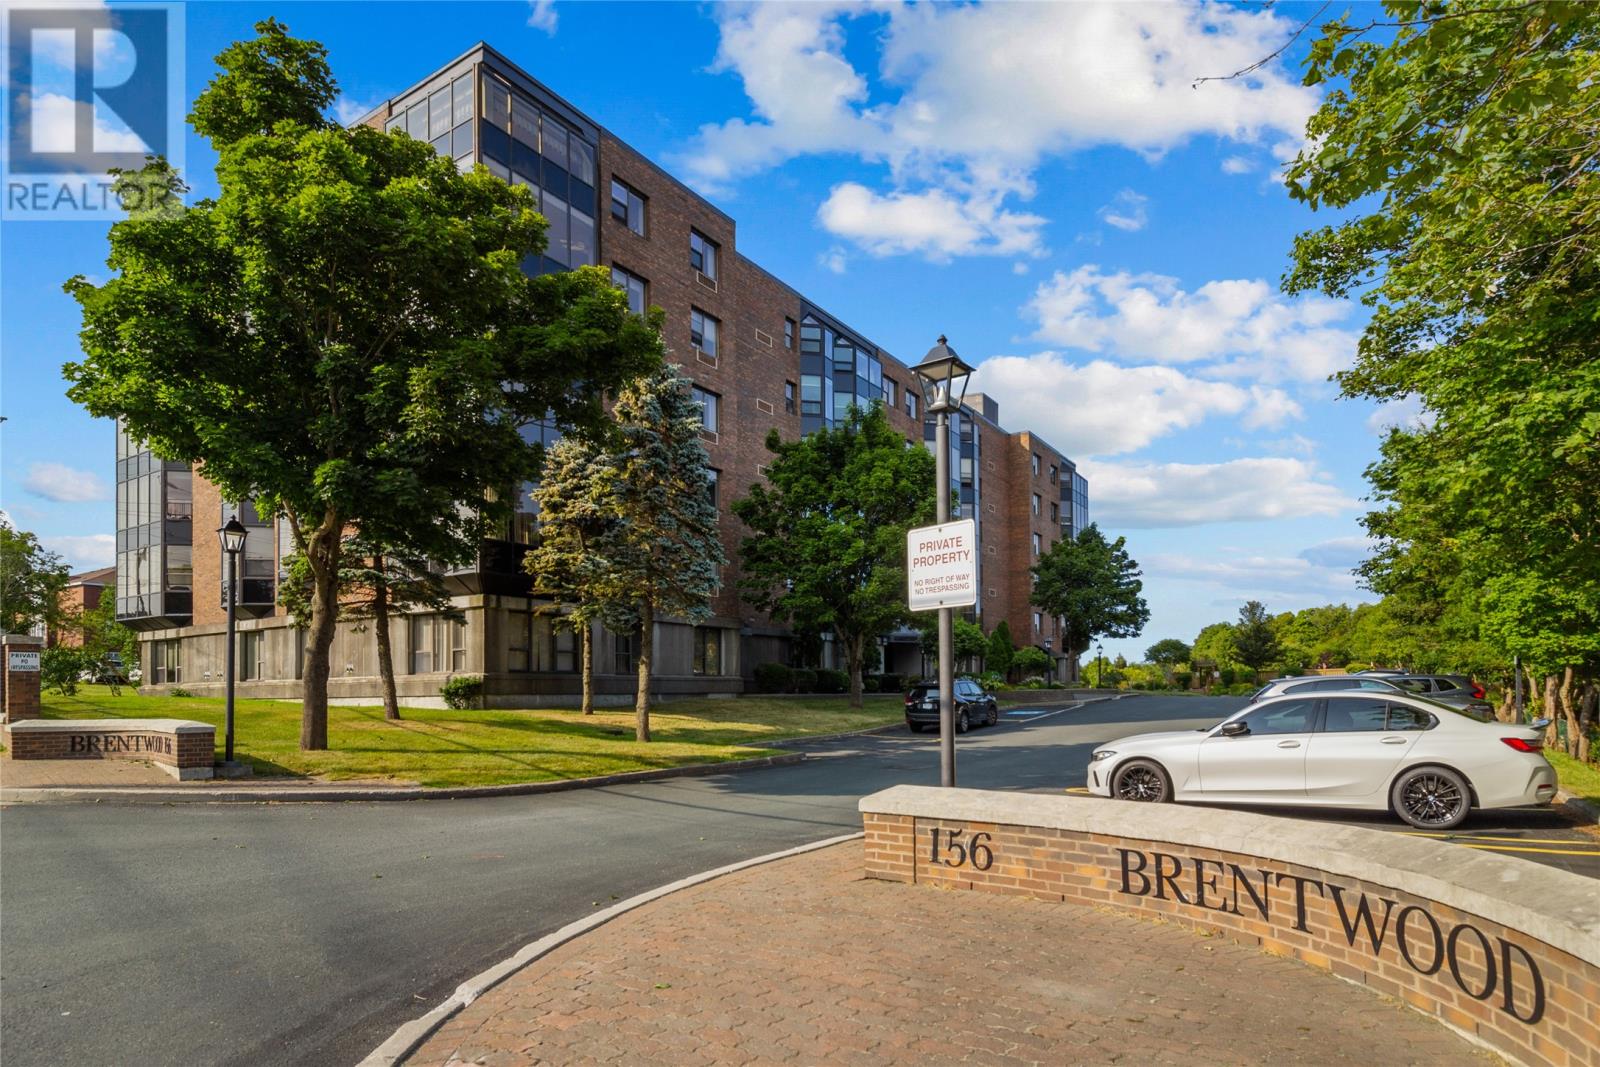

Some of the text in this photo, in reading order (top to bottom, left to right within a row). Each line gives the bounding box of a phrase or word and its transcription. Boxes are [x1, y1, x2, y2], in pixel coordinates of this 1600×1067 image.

[919, 536, 962, 553] PRIVATE
[913, 549, 970, 568] PROPERTY
[914, 573, 970, 587] NO RIGHT OF WAY
[915, 582, 970, 595] NO TRESPASSING
[928, 827, 1546, 1026] 156 BRENTWOOD
